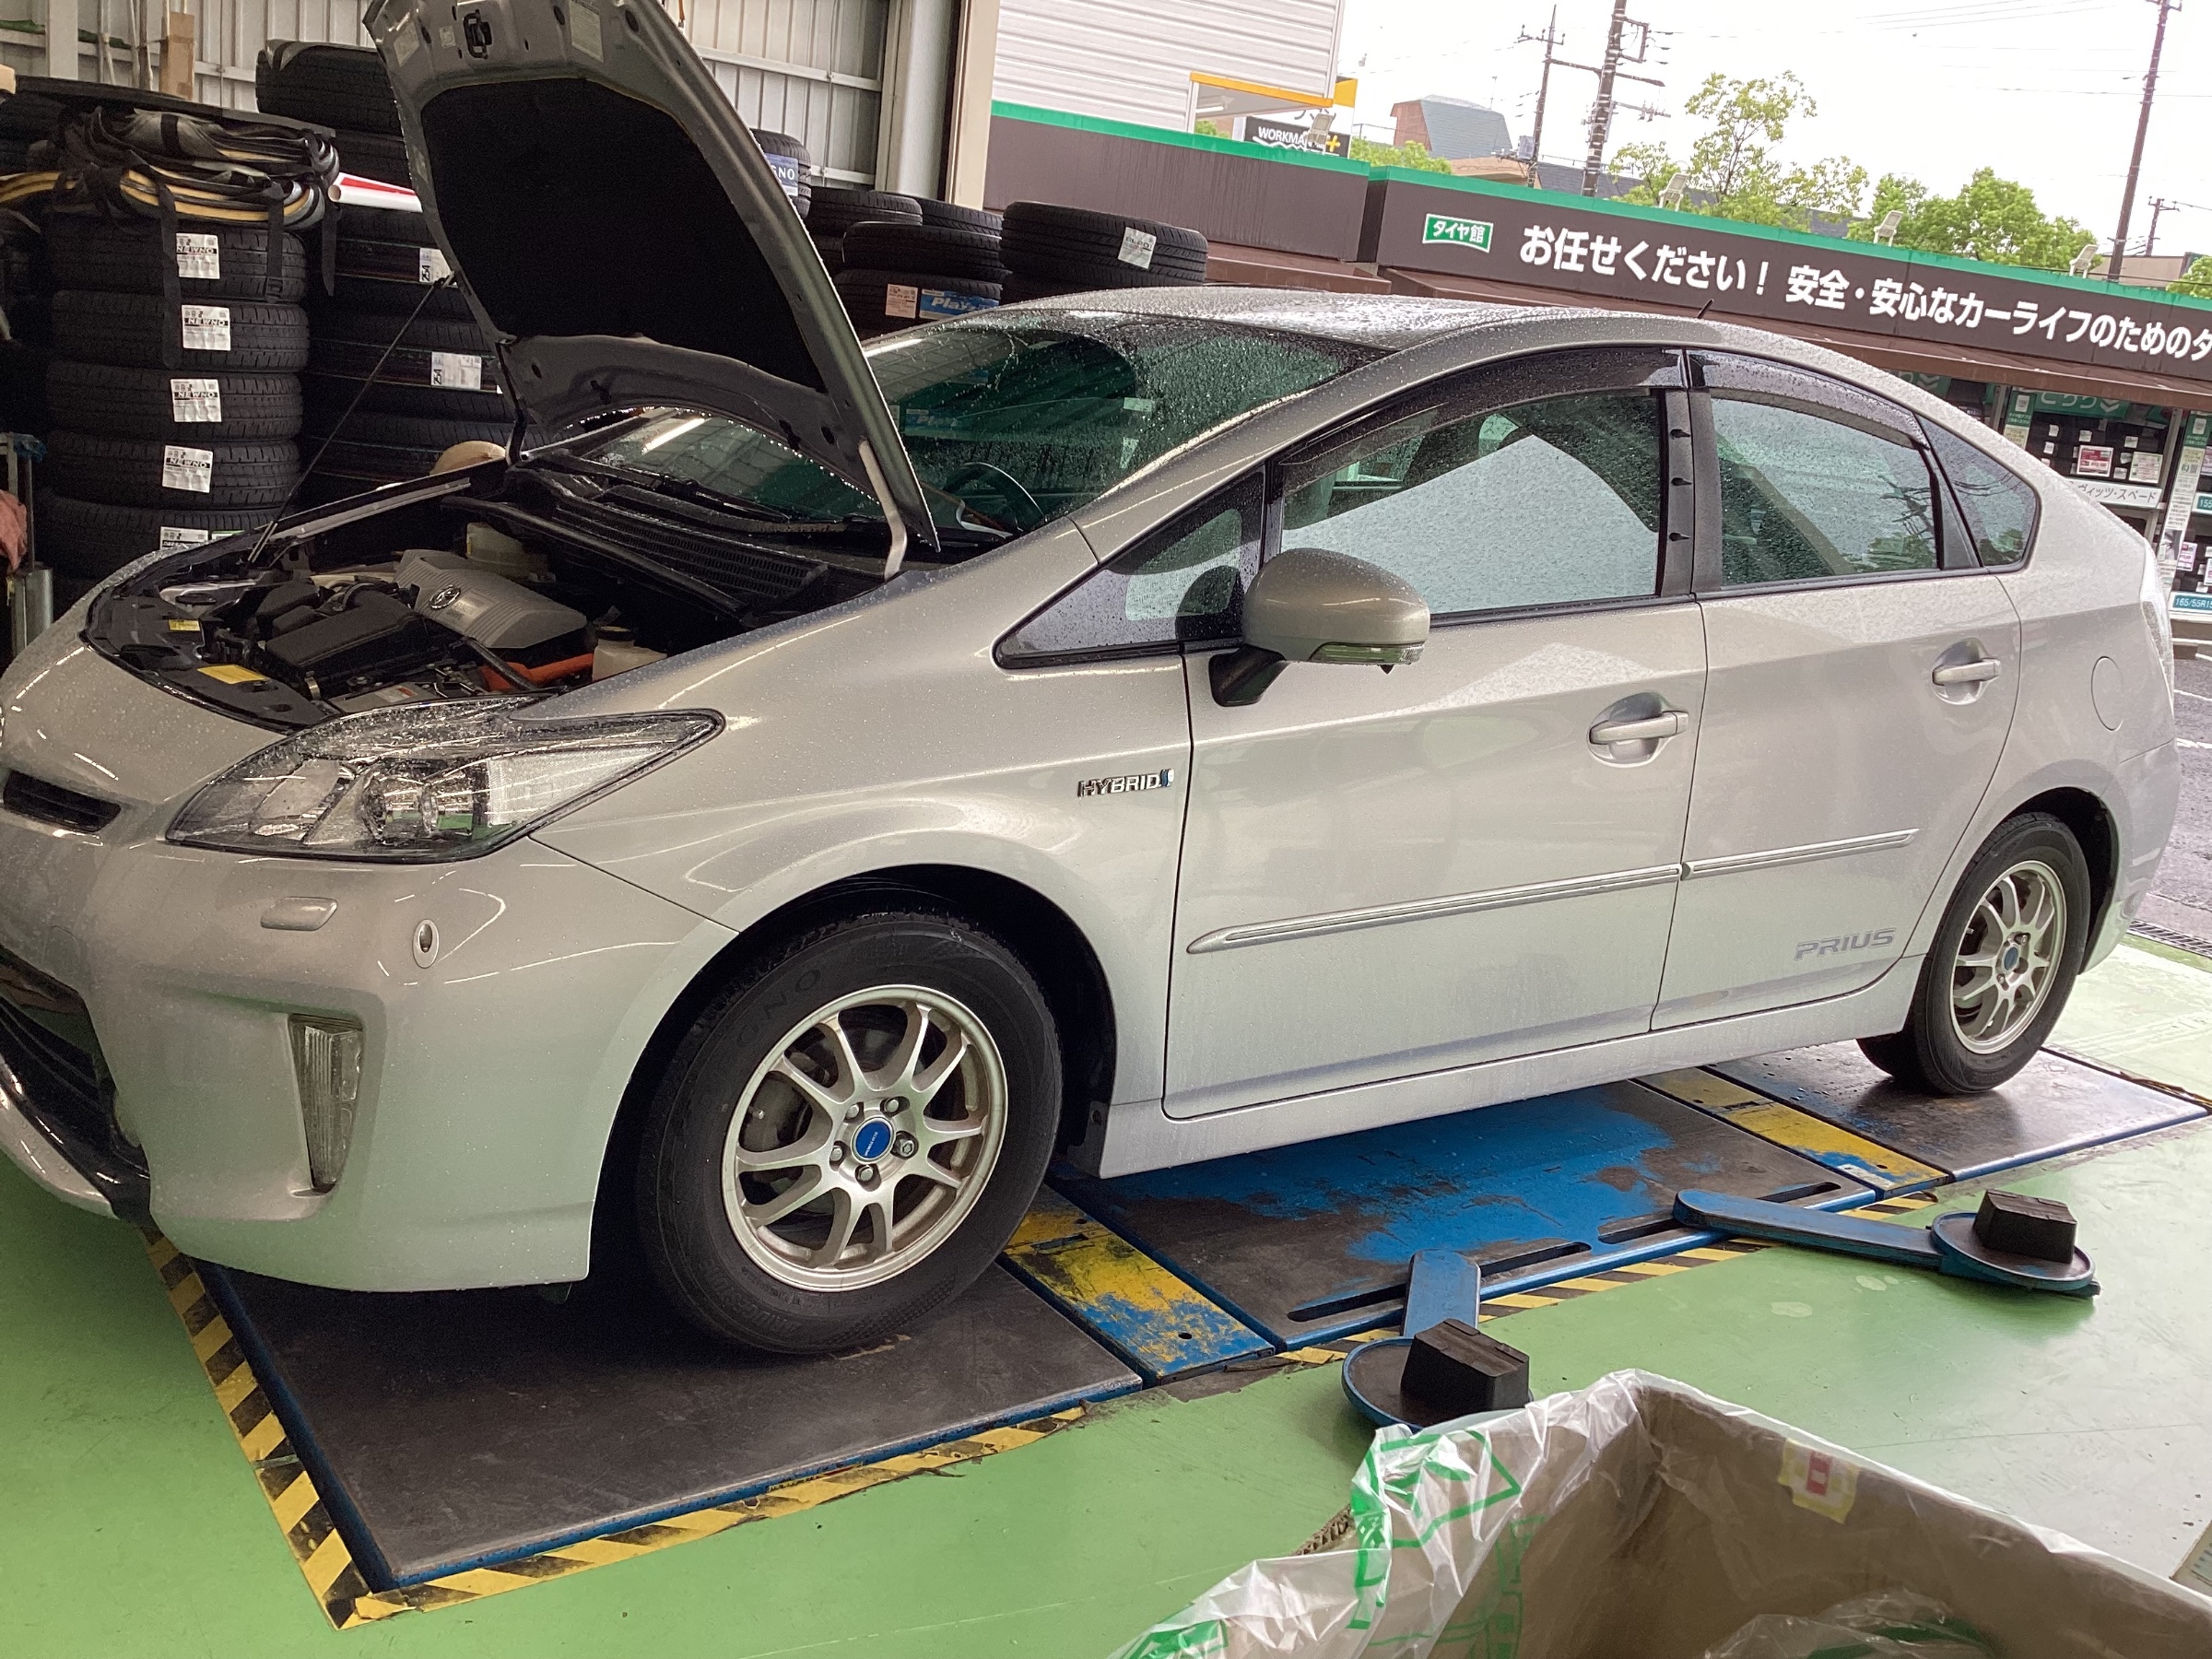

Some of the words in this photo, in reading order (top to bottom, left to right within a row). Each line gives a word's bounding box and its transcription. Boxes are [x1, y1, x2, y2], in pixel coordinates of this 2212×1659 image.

[1257, 126, 1309, 146] WORKMA
[1433, 219, 1486, 244] タイヤ館
[177, 246, 214, 254] NEWNO
[1520, 225, 1770, 296] お任せください！
[188, 318, 226, 326] NEWNO
[170, 457, 207, 468] NEWNO
[1077, 773, 1161, 797] HYBRID
[1794, 927, 1896, 960] PRIUS
